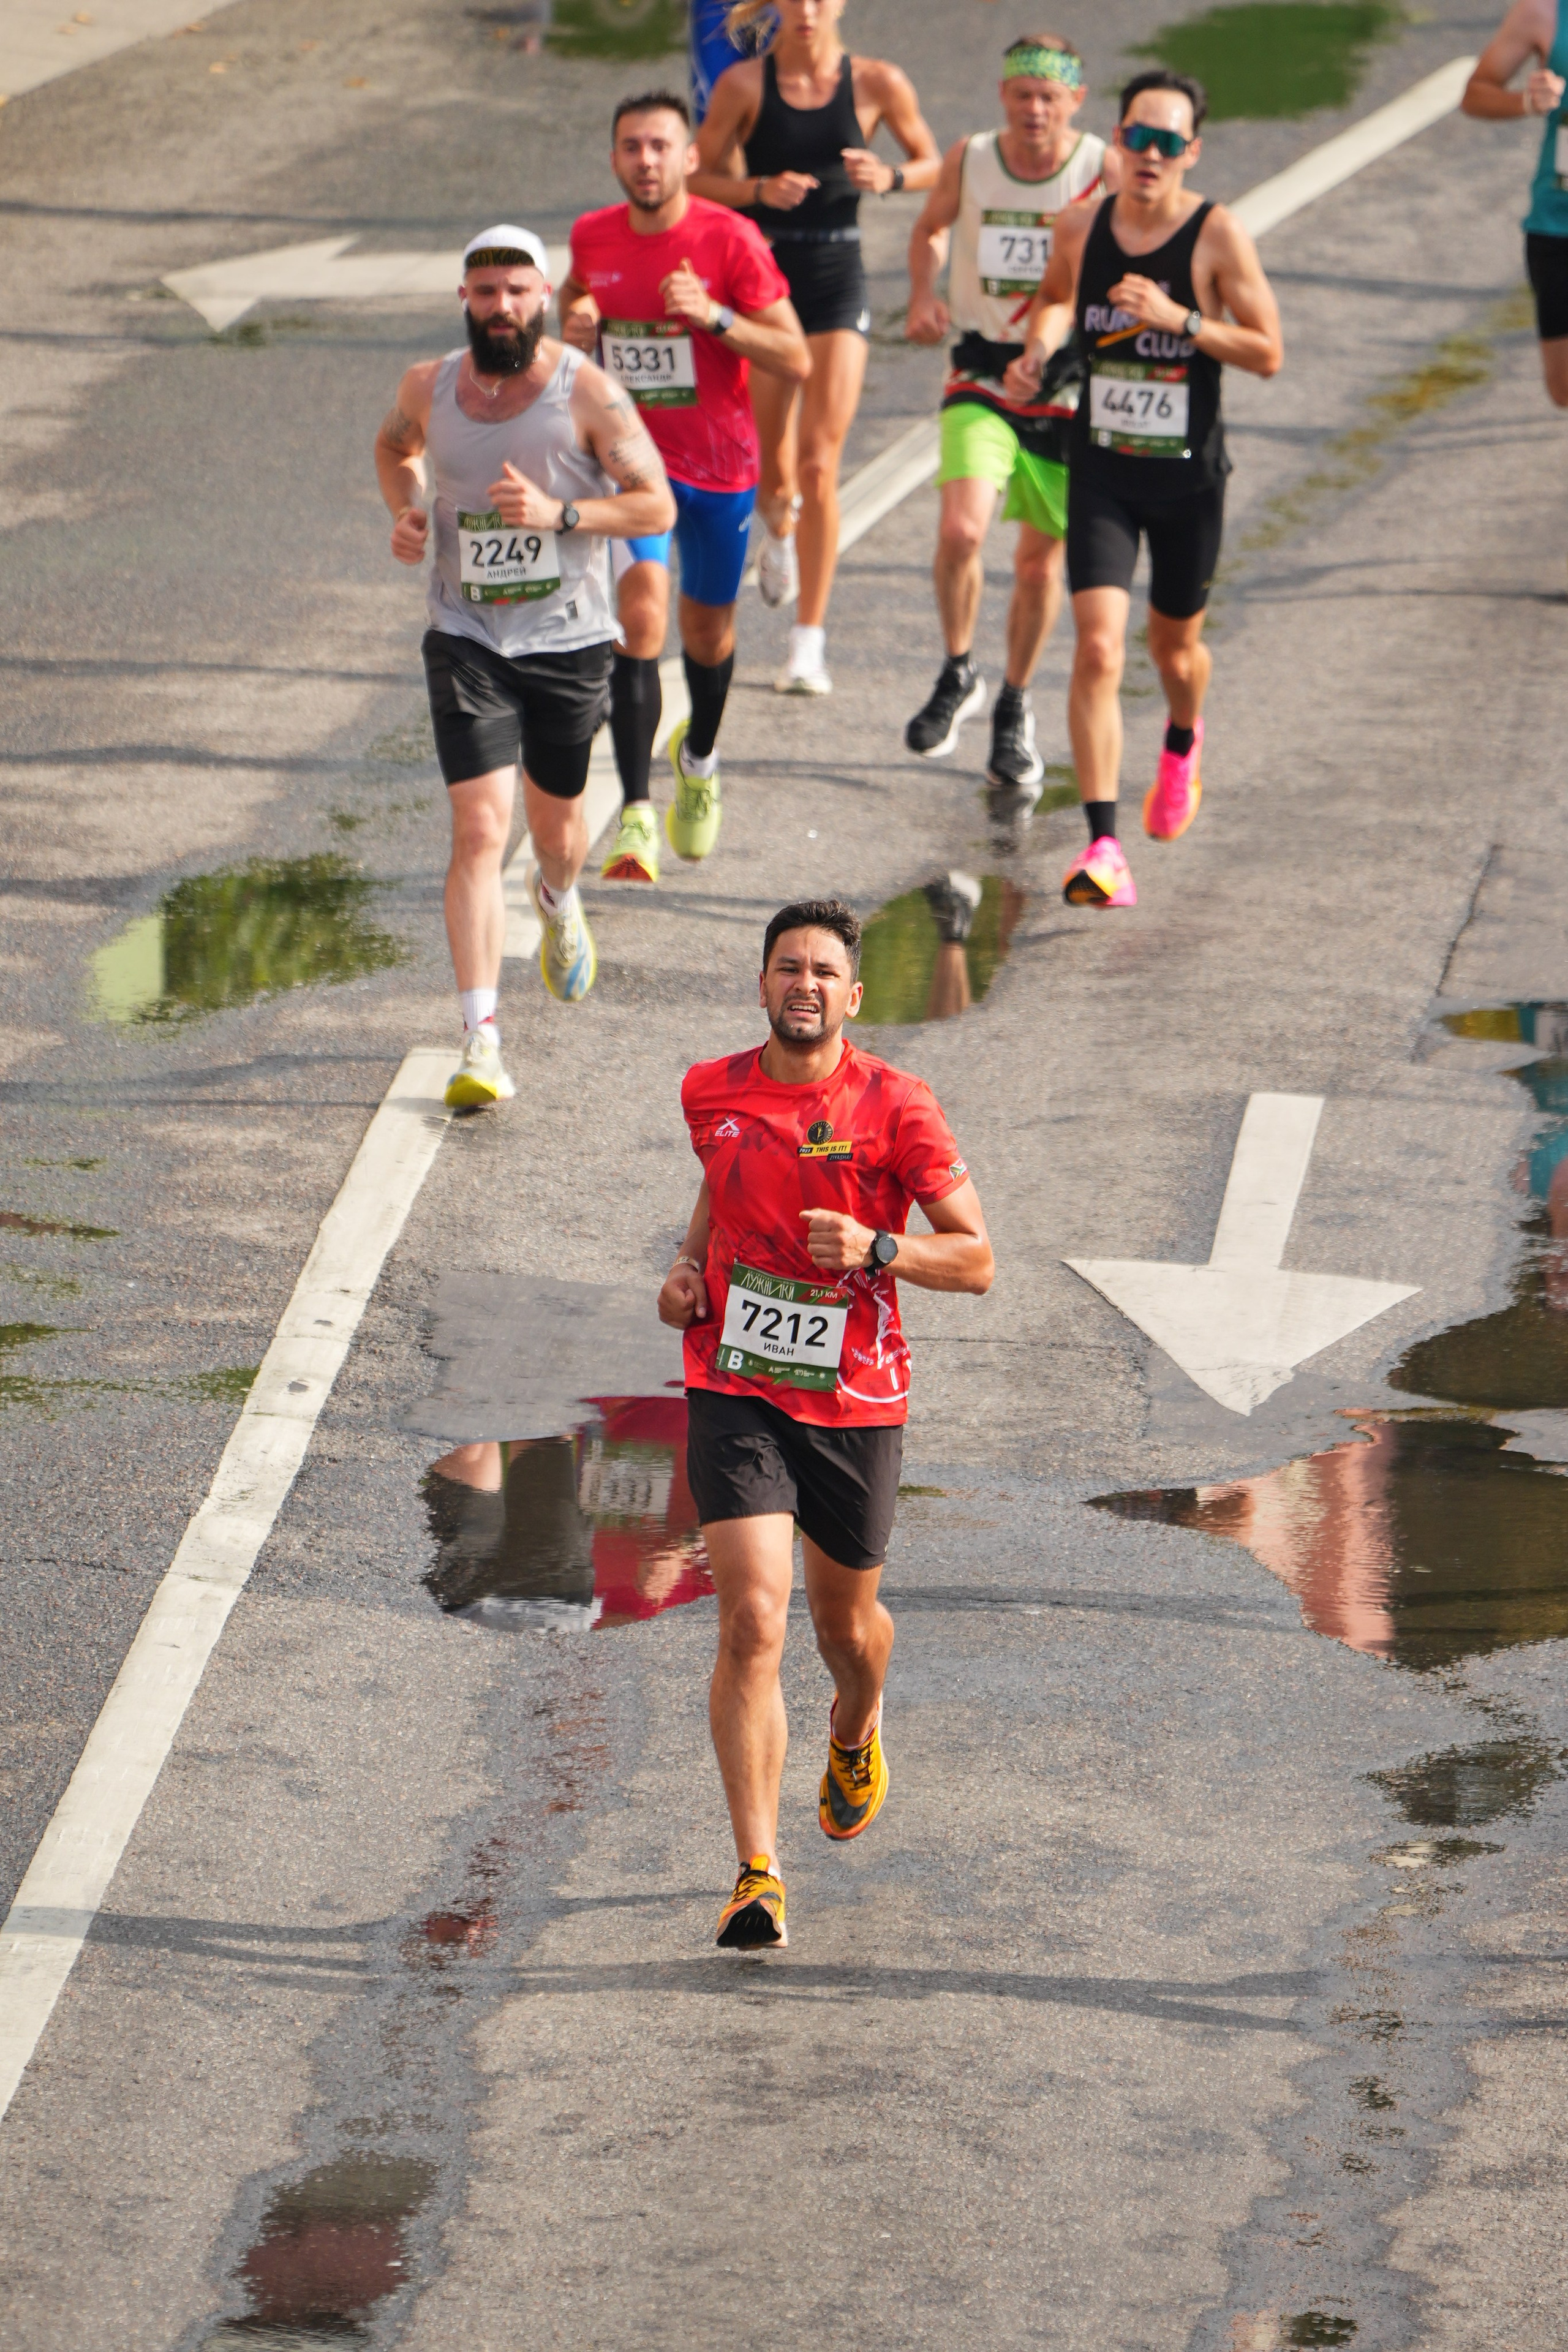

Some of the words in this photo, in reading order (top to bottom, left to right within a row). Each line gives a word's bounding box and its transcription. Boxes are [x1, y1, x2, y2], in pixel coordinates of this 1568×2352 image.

[1135, 330, 1196, 359] CLUB
[612, 345, 675, 372] 5331
[1102, 387, 1172, 420] 4476
[470, 535, 541, 568] 2249
[487, 567, 526, 579] АНДРЕЙ
[470, 586, 481, 601] B
[810, 1289, 823, 1298] 21,1
[741, 1299, 828, 1348] 7212
[727, 1350, 744, 1370] B
[763, 1342, 794, 1357] ИВАН
